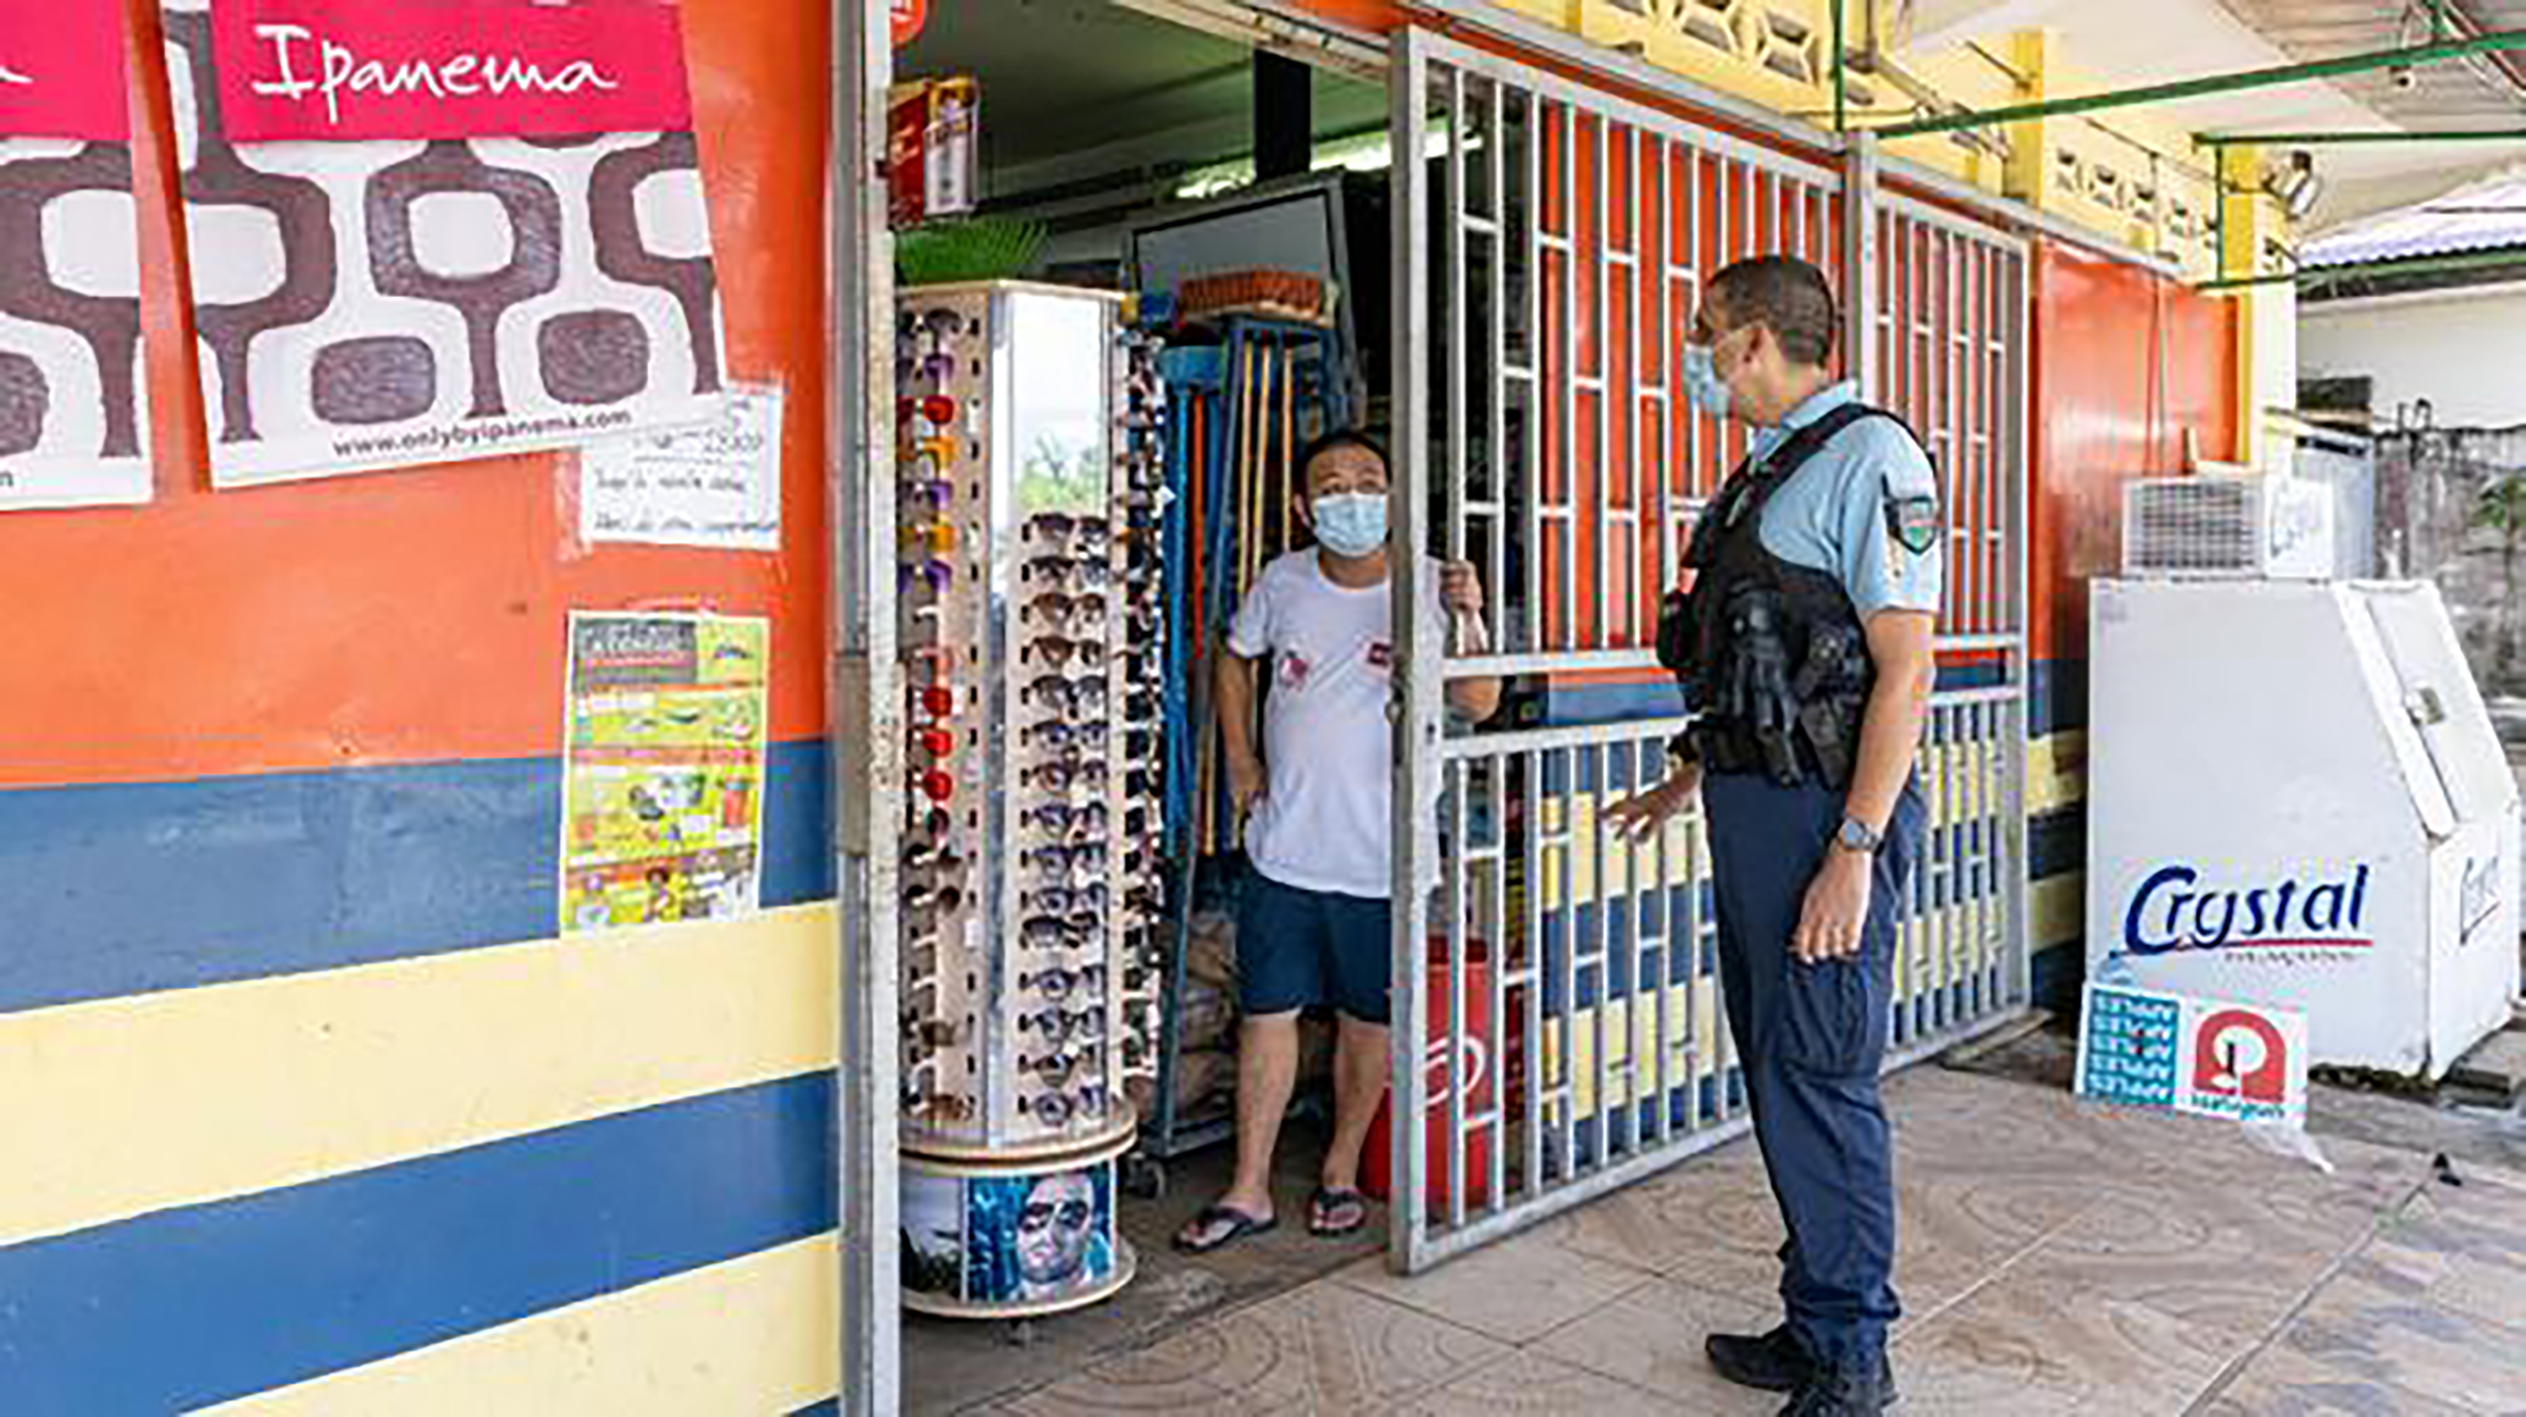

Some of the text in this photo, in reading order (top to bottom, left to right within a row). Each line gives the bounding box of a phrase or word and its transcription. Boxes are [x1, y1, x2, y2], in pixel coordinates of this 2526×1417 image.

[252, 22, 616, 123] Ipanema
[331, 410, 632, 456] www.onlybyipanema.com
[2124, 864, 2370, 955] Crystal
